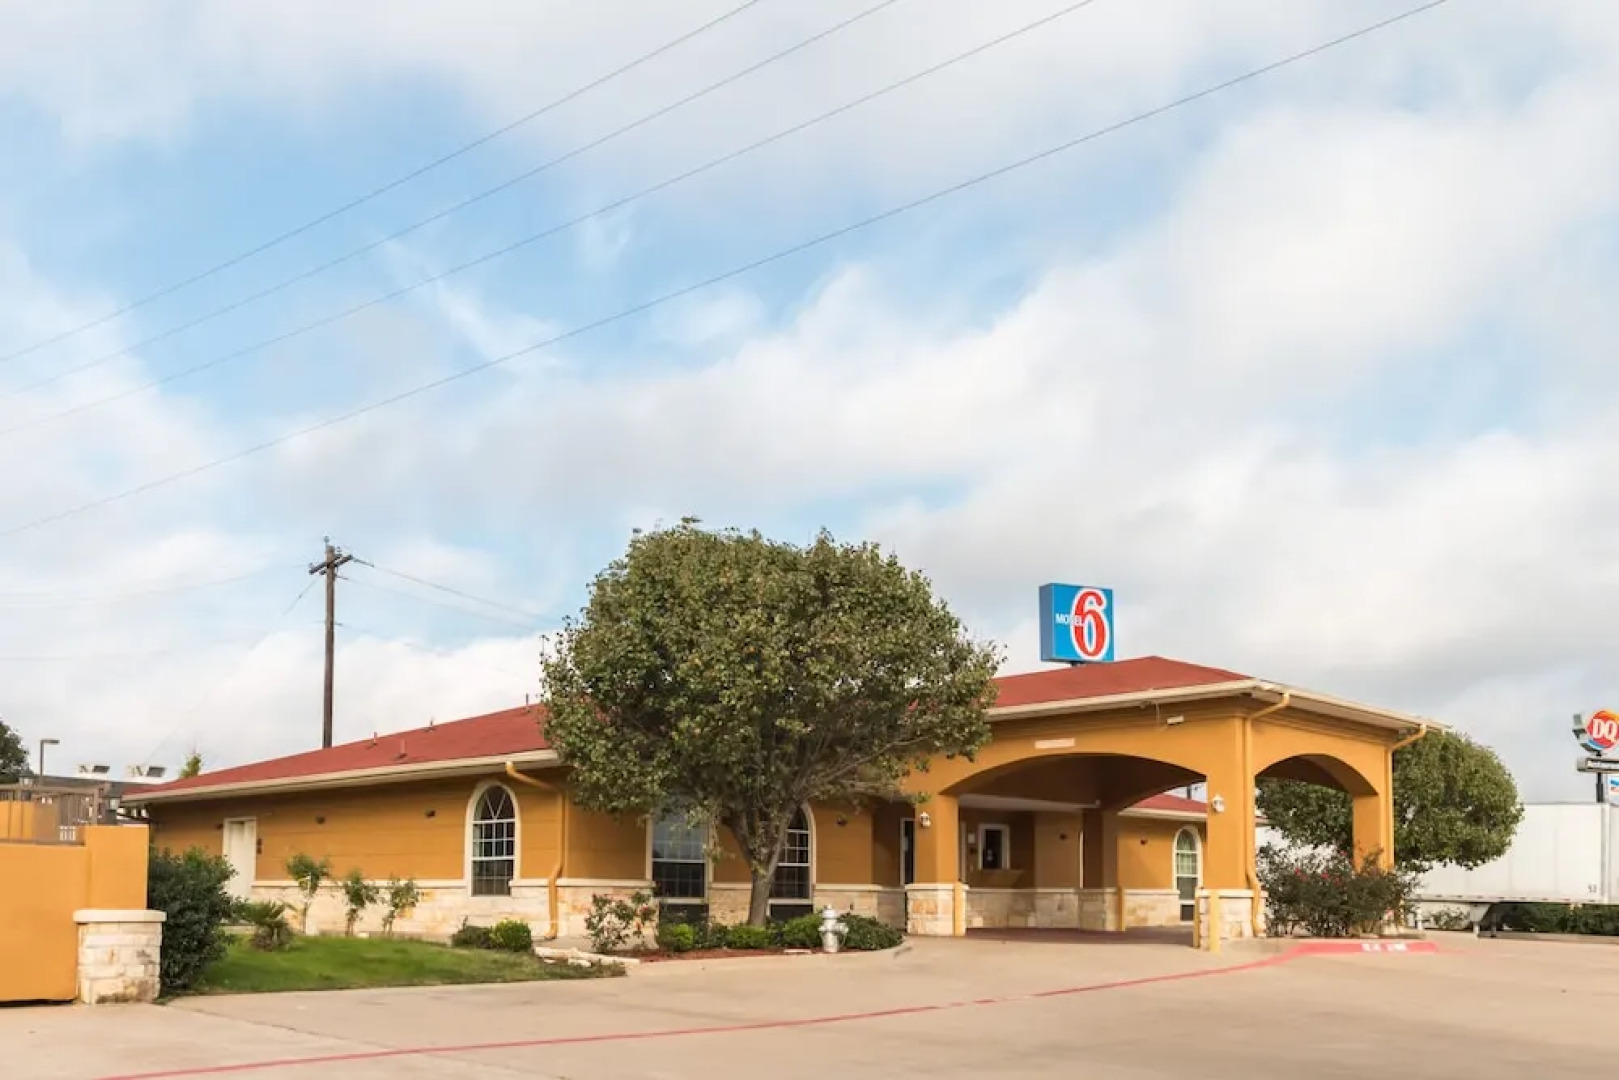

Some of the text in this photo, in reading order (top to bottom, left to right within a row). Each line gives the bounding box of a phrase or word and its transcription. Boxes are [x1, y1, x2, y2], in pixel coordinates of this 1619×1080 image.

[1055, 589, 1107, 658] MOEL 6
[1592, 718, 1618, 742] DQ
